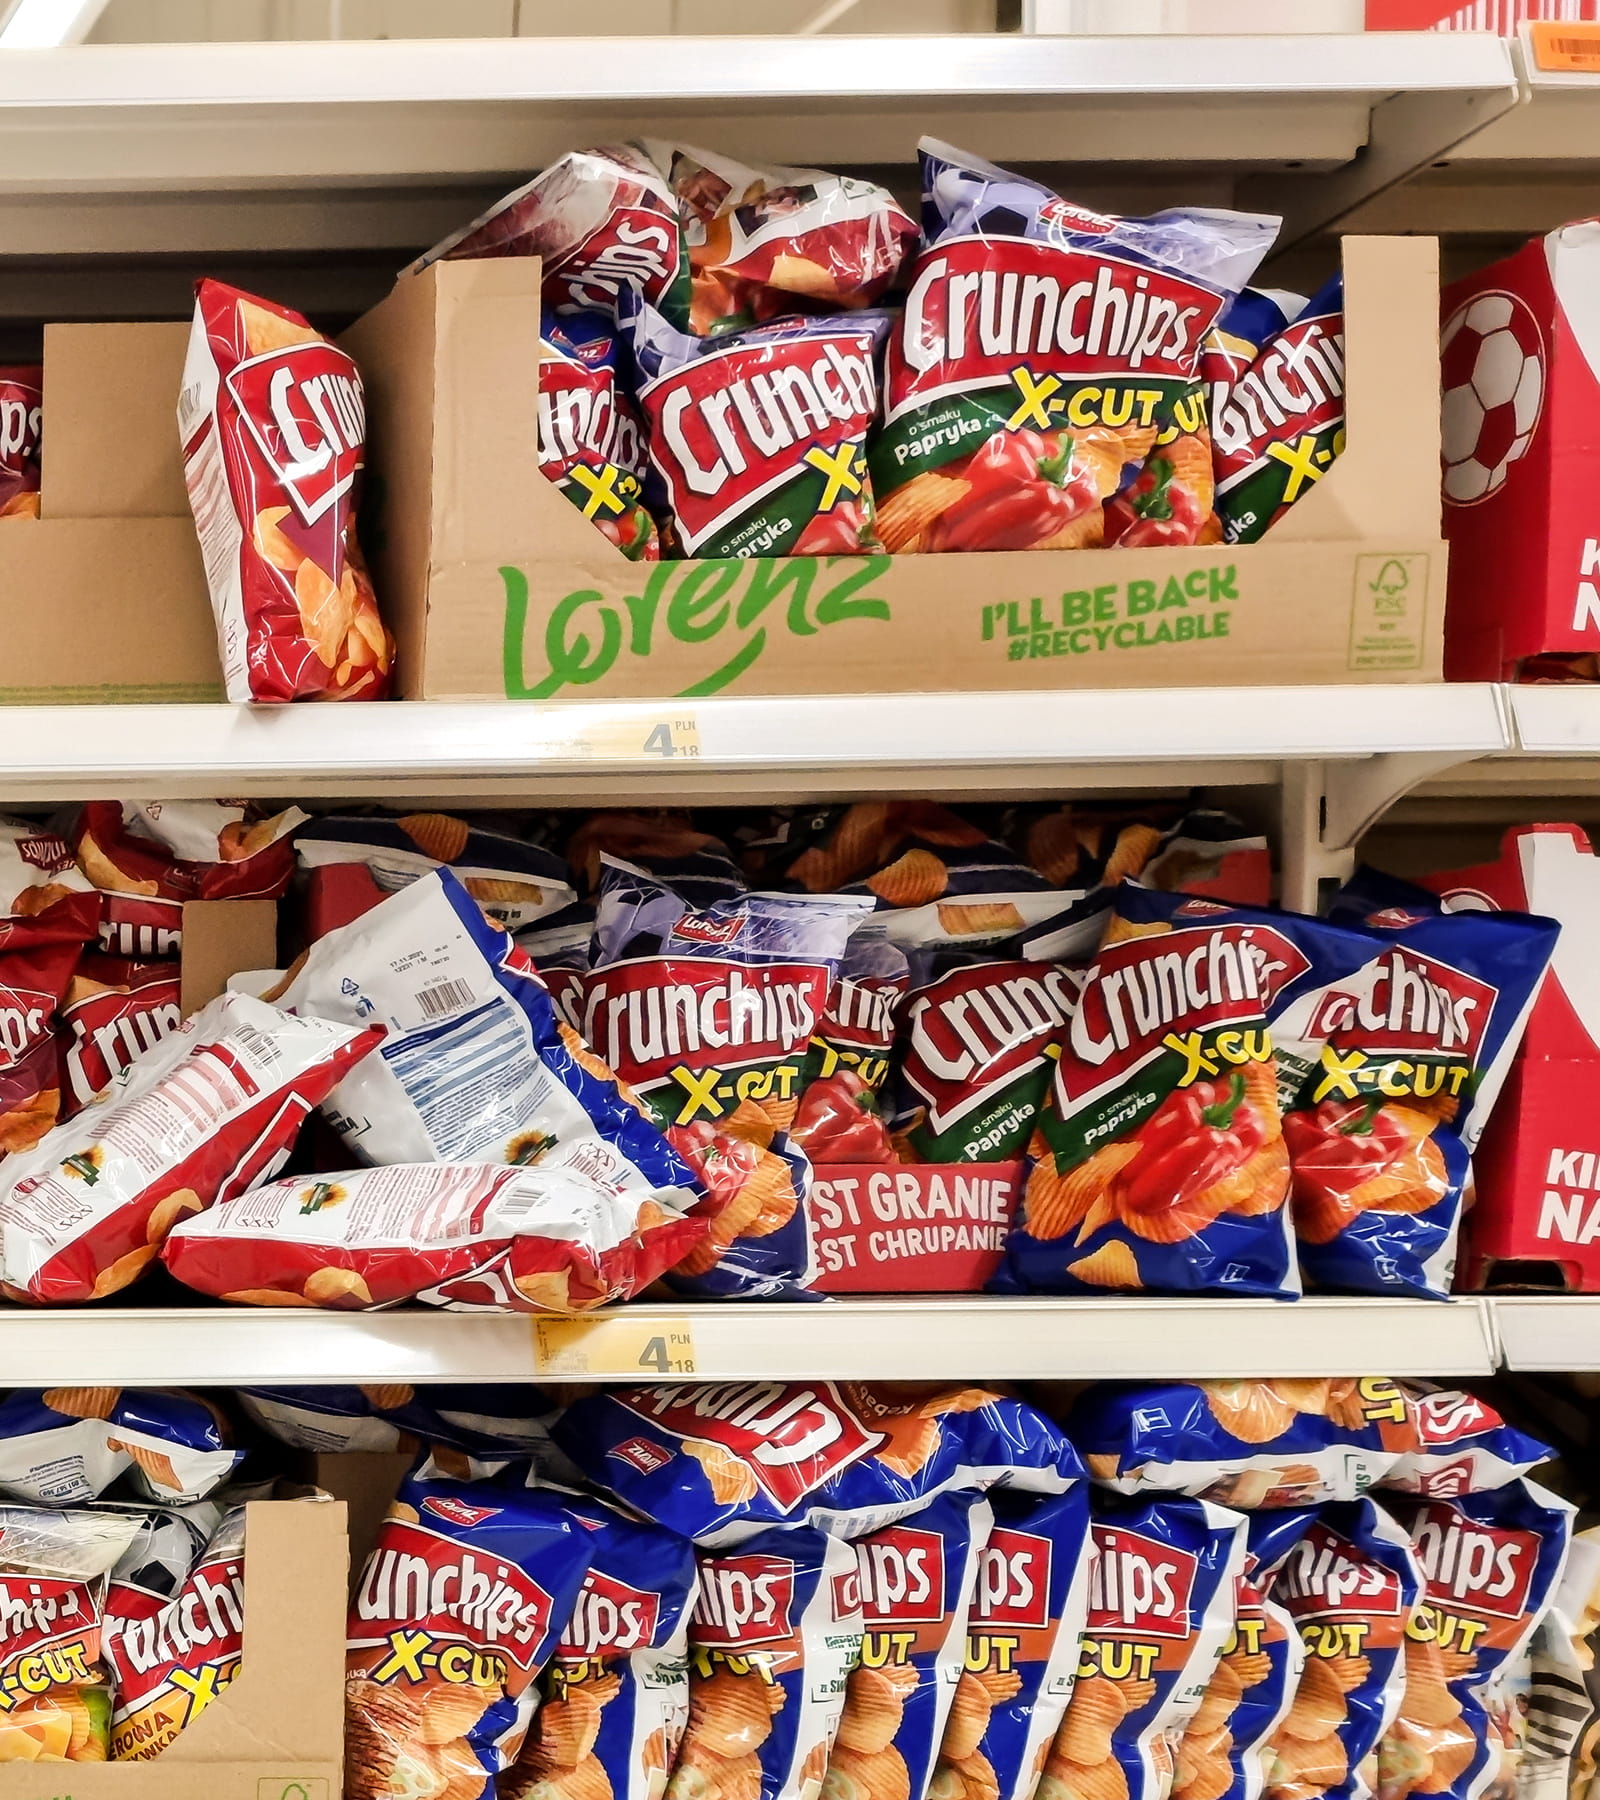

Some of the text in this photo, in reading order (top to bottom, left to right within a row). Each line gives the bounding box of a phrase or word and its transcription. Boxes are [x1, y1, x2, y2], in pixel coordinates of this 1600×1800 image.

[904, 259, 1200, 370] Crunchips
[920, 407, 961, 433] smaku
[1007, 367, 1163, 432] X-CUT
[895, 415, 982, 466] Papryka
[500, 556, 892, 700] Lorenz
[982, 563, 1238, 641] I'LL BE BACK
[1007, 611, 1231, 661] #RECYCLABLE
[643, 724, 678, 756] 4
[593, 970, 815, 1067] Crunchips
[1312, 1046, 1470, 1103] X-CUT
[964, 1102, 1036, 1162] Papryka
[1084, 1089, 1156, 1147] Papryka
[868, 1173, 1010, 1225] GRANIE
[868, 1227, 1008, 1263] CHRUPANIE
[639, 1334, 690, 1373] 4 PLN
[675, 1359, 694, 1373] 18
